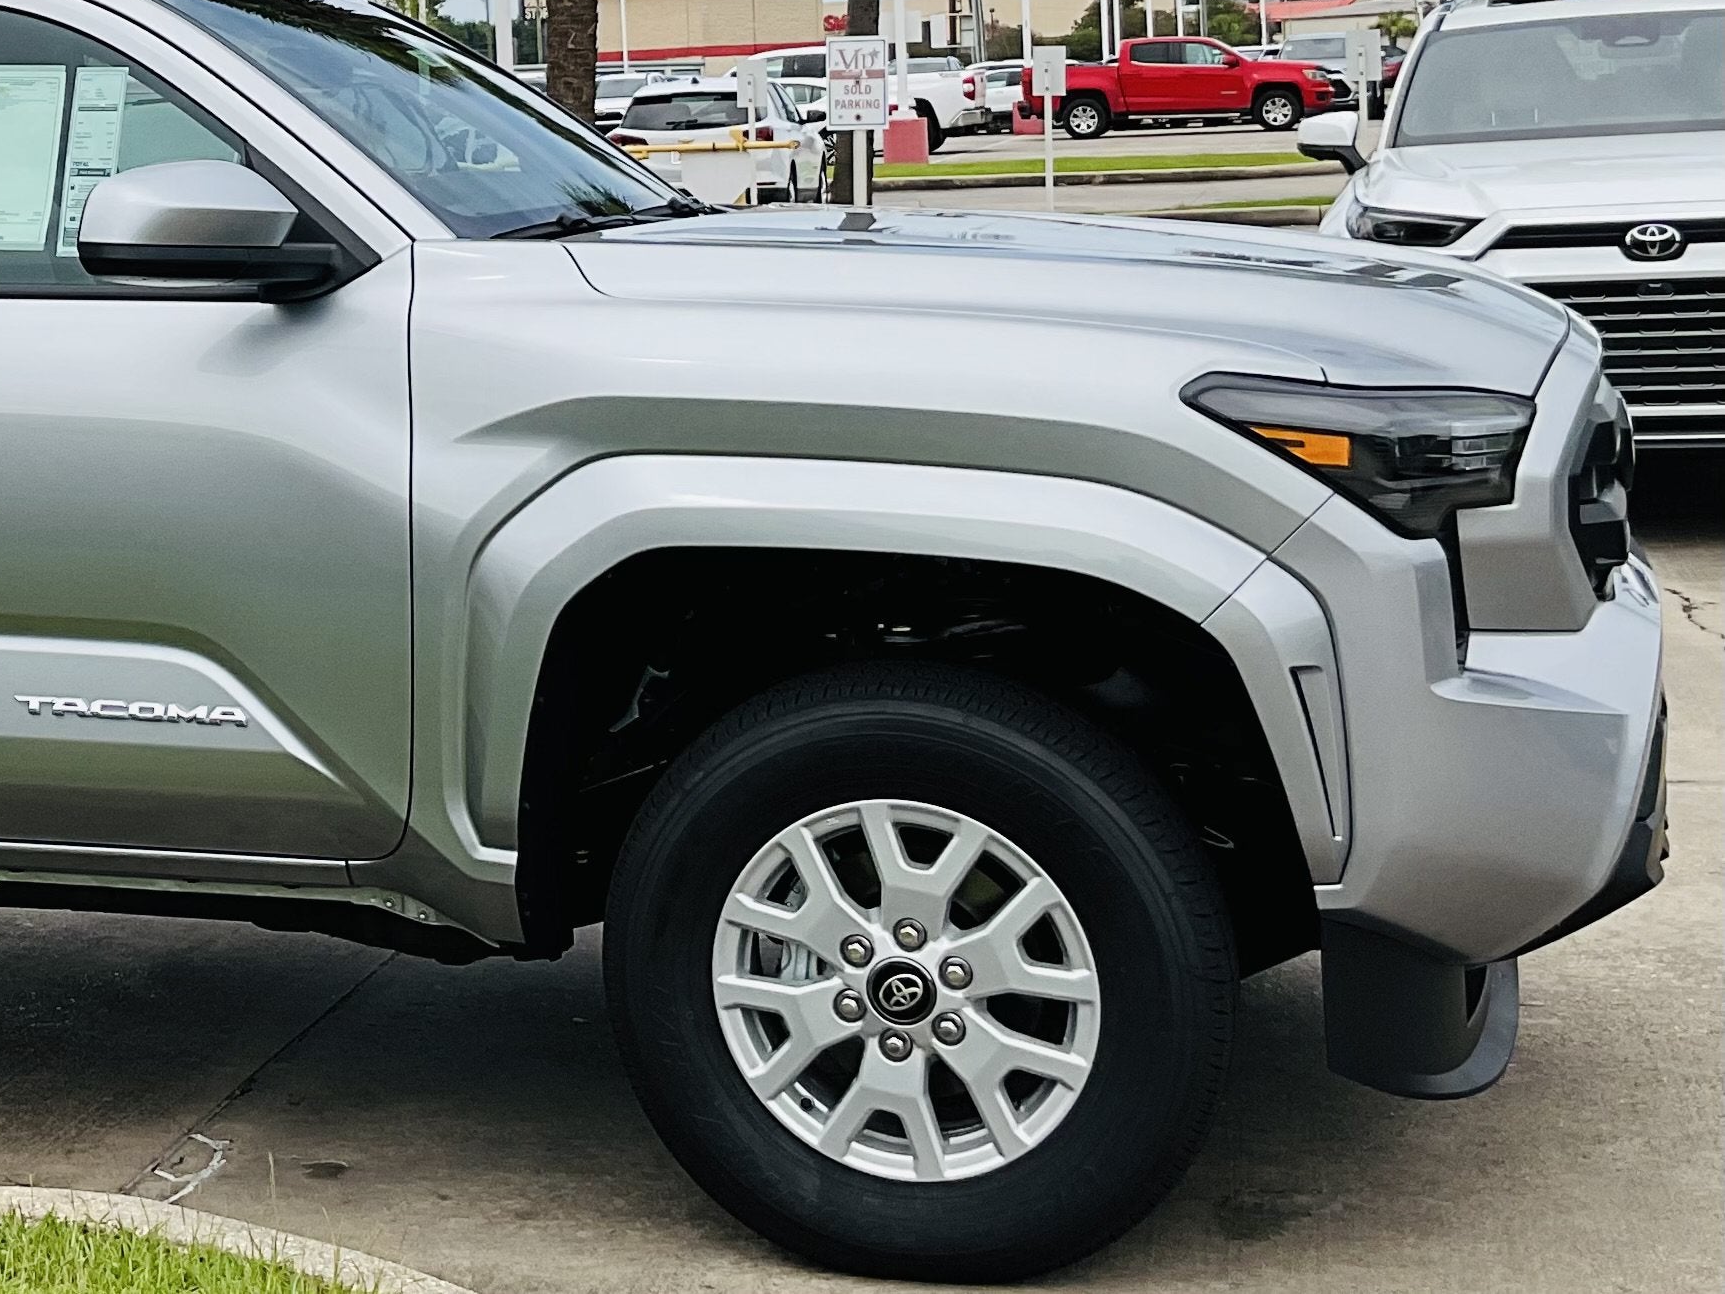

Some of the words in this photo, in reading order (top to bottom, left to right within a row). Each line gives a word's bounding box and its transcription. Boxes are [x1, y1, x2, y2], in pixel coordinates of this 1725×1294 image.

[843, 84, 872, 95] SOLD
[834, 98, 881, 110] PARKING
[13, 693, 250, 728] TACOMA
